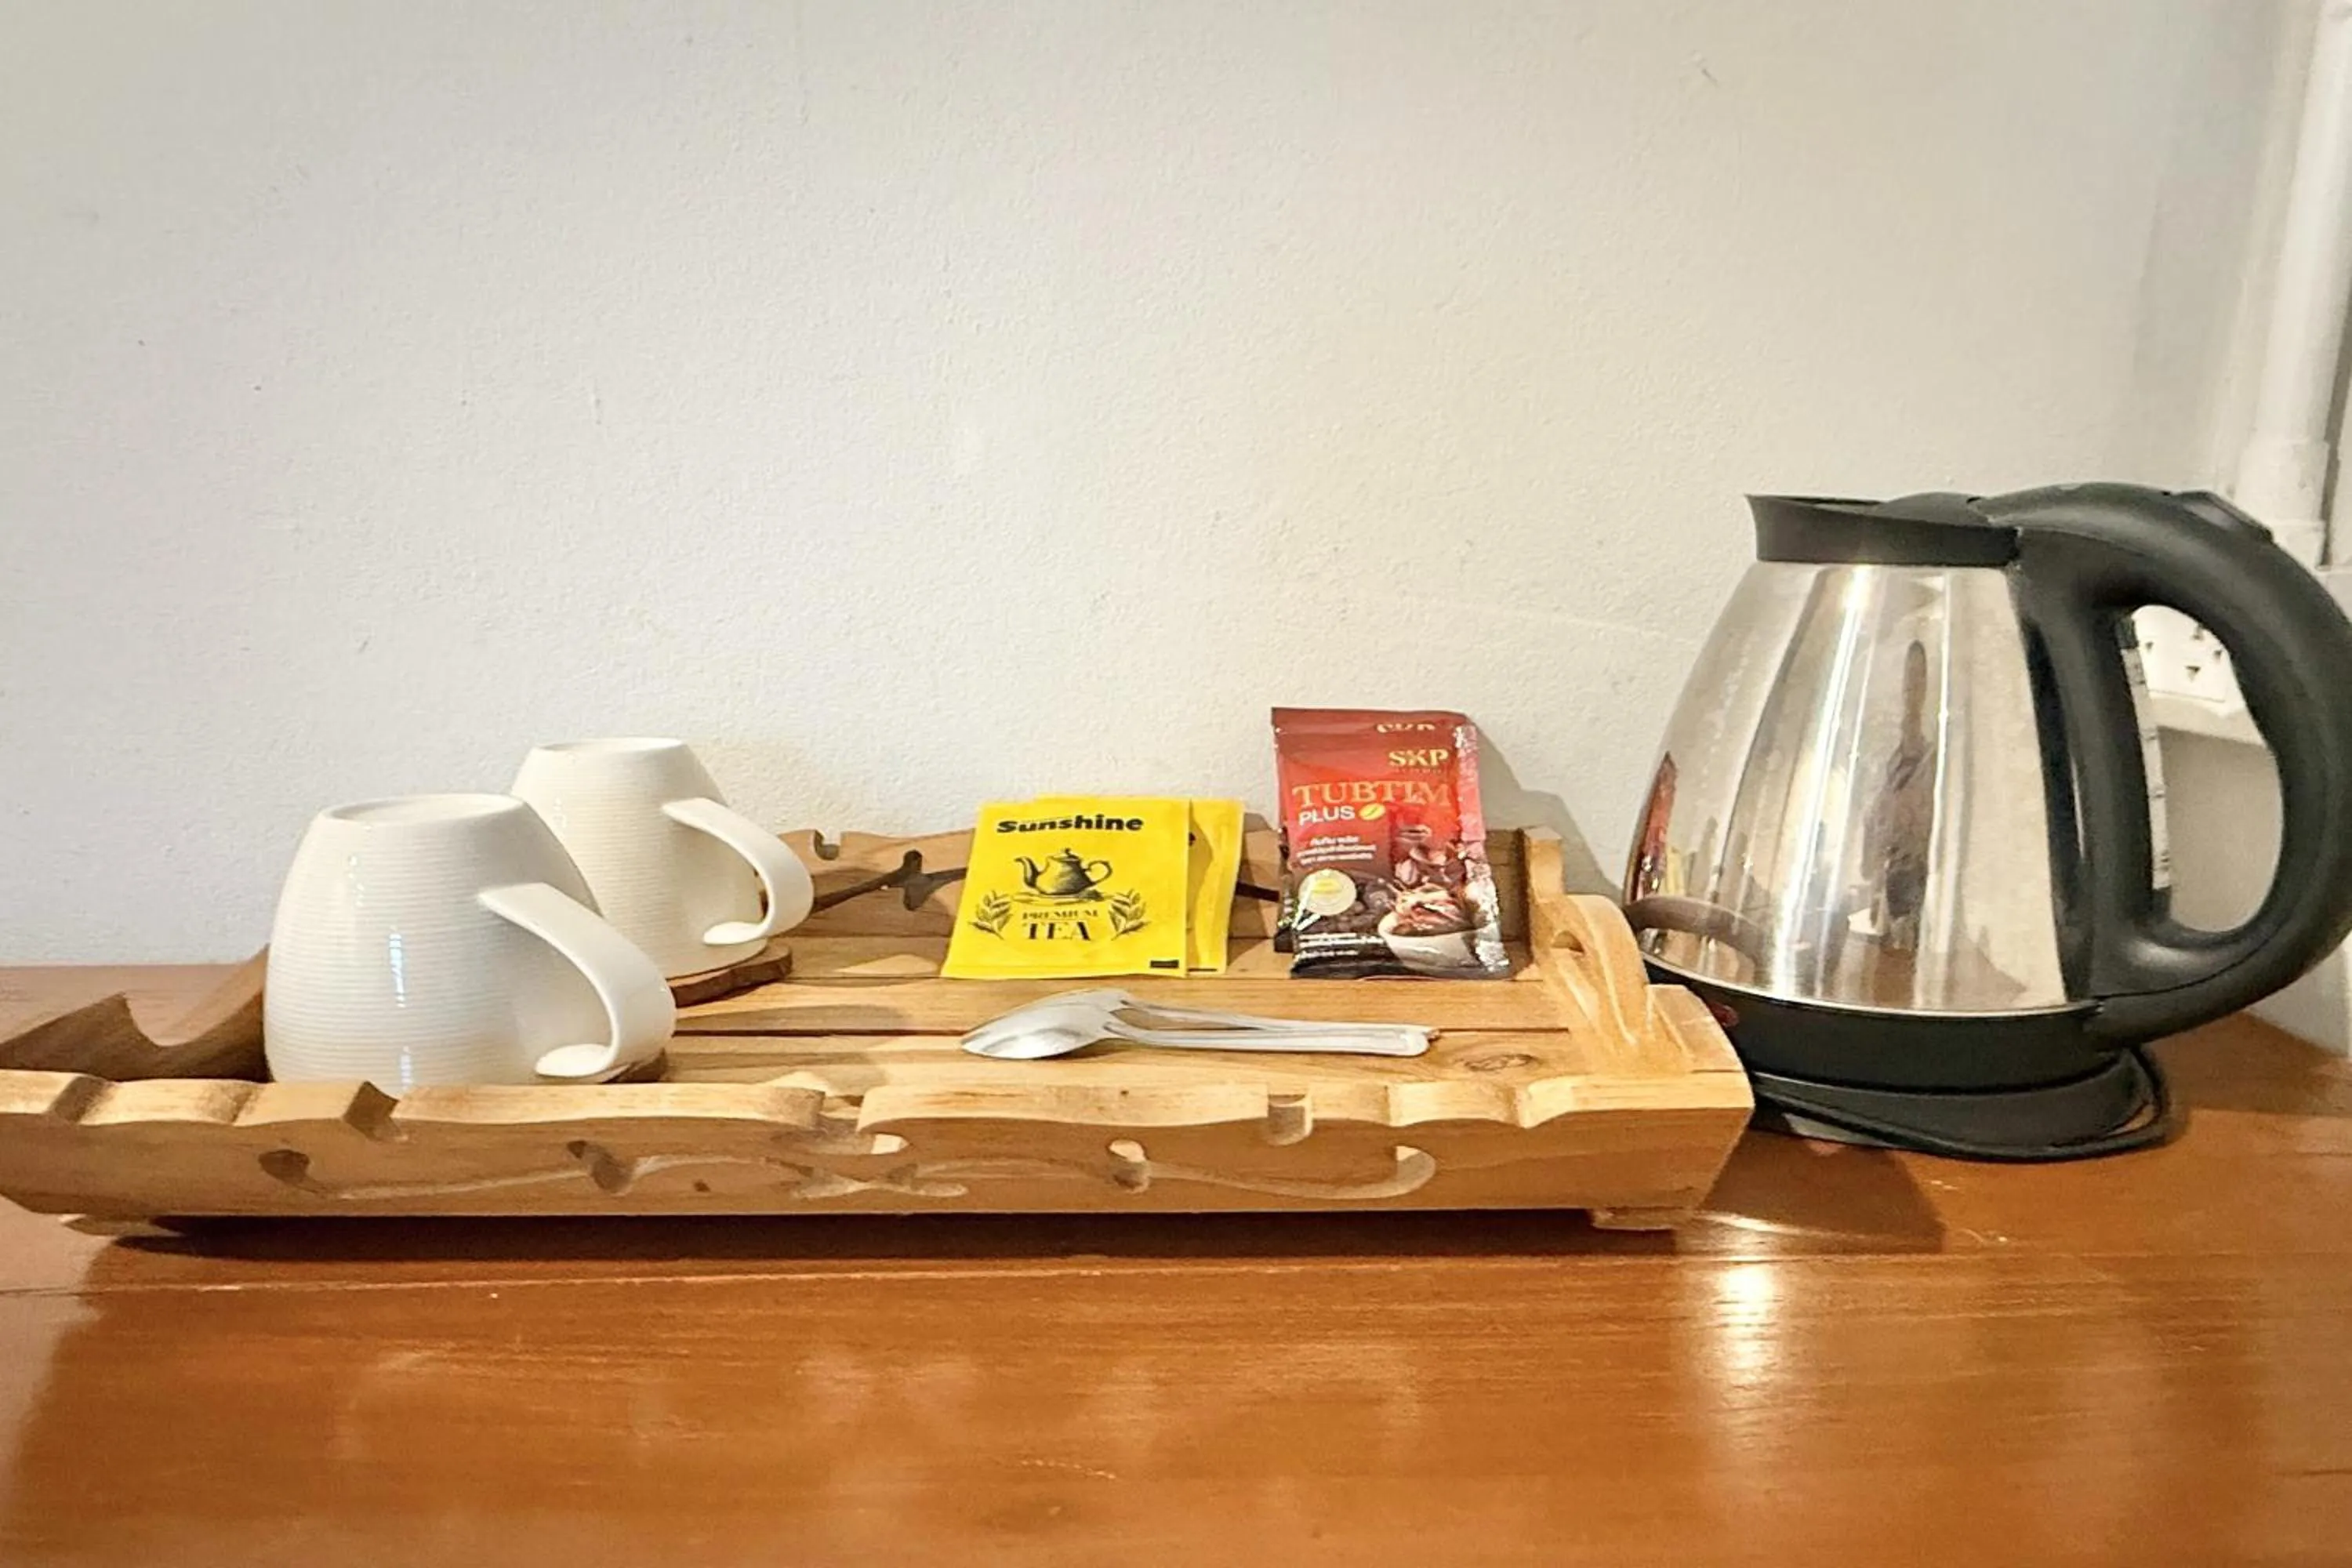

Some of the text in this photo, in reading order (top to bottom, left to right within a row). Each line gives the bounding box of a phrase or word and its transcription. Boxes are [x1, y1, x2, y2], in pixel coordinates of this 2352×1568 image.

[1388, 749, 1450, 767] SKP
[1292, 780, 1451, 809] TUBTIM
[996, 814, 1144, 833] Sunshine
[1298, 805, 1356, 826] PLUS
[1022, 920, 1091, 941] TEA
